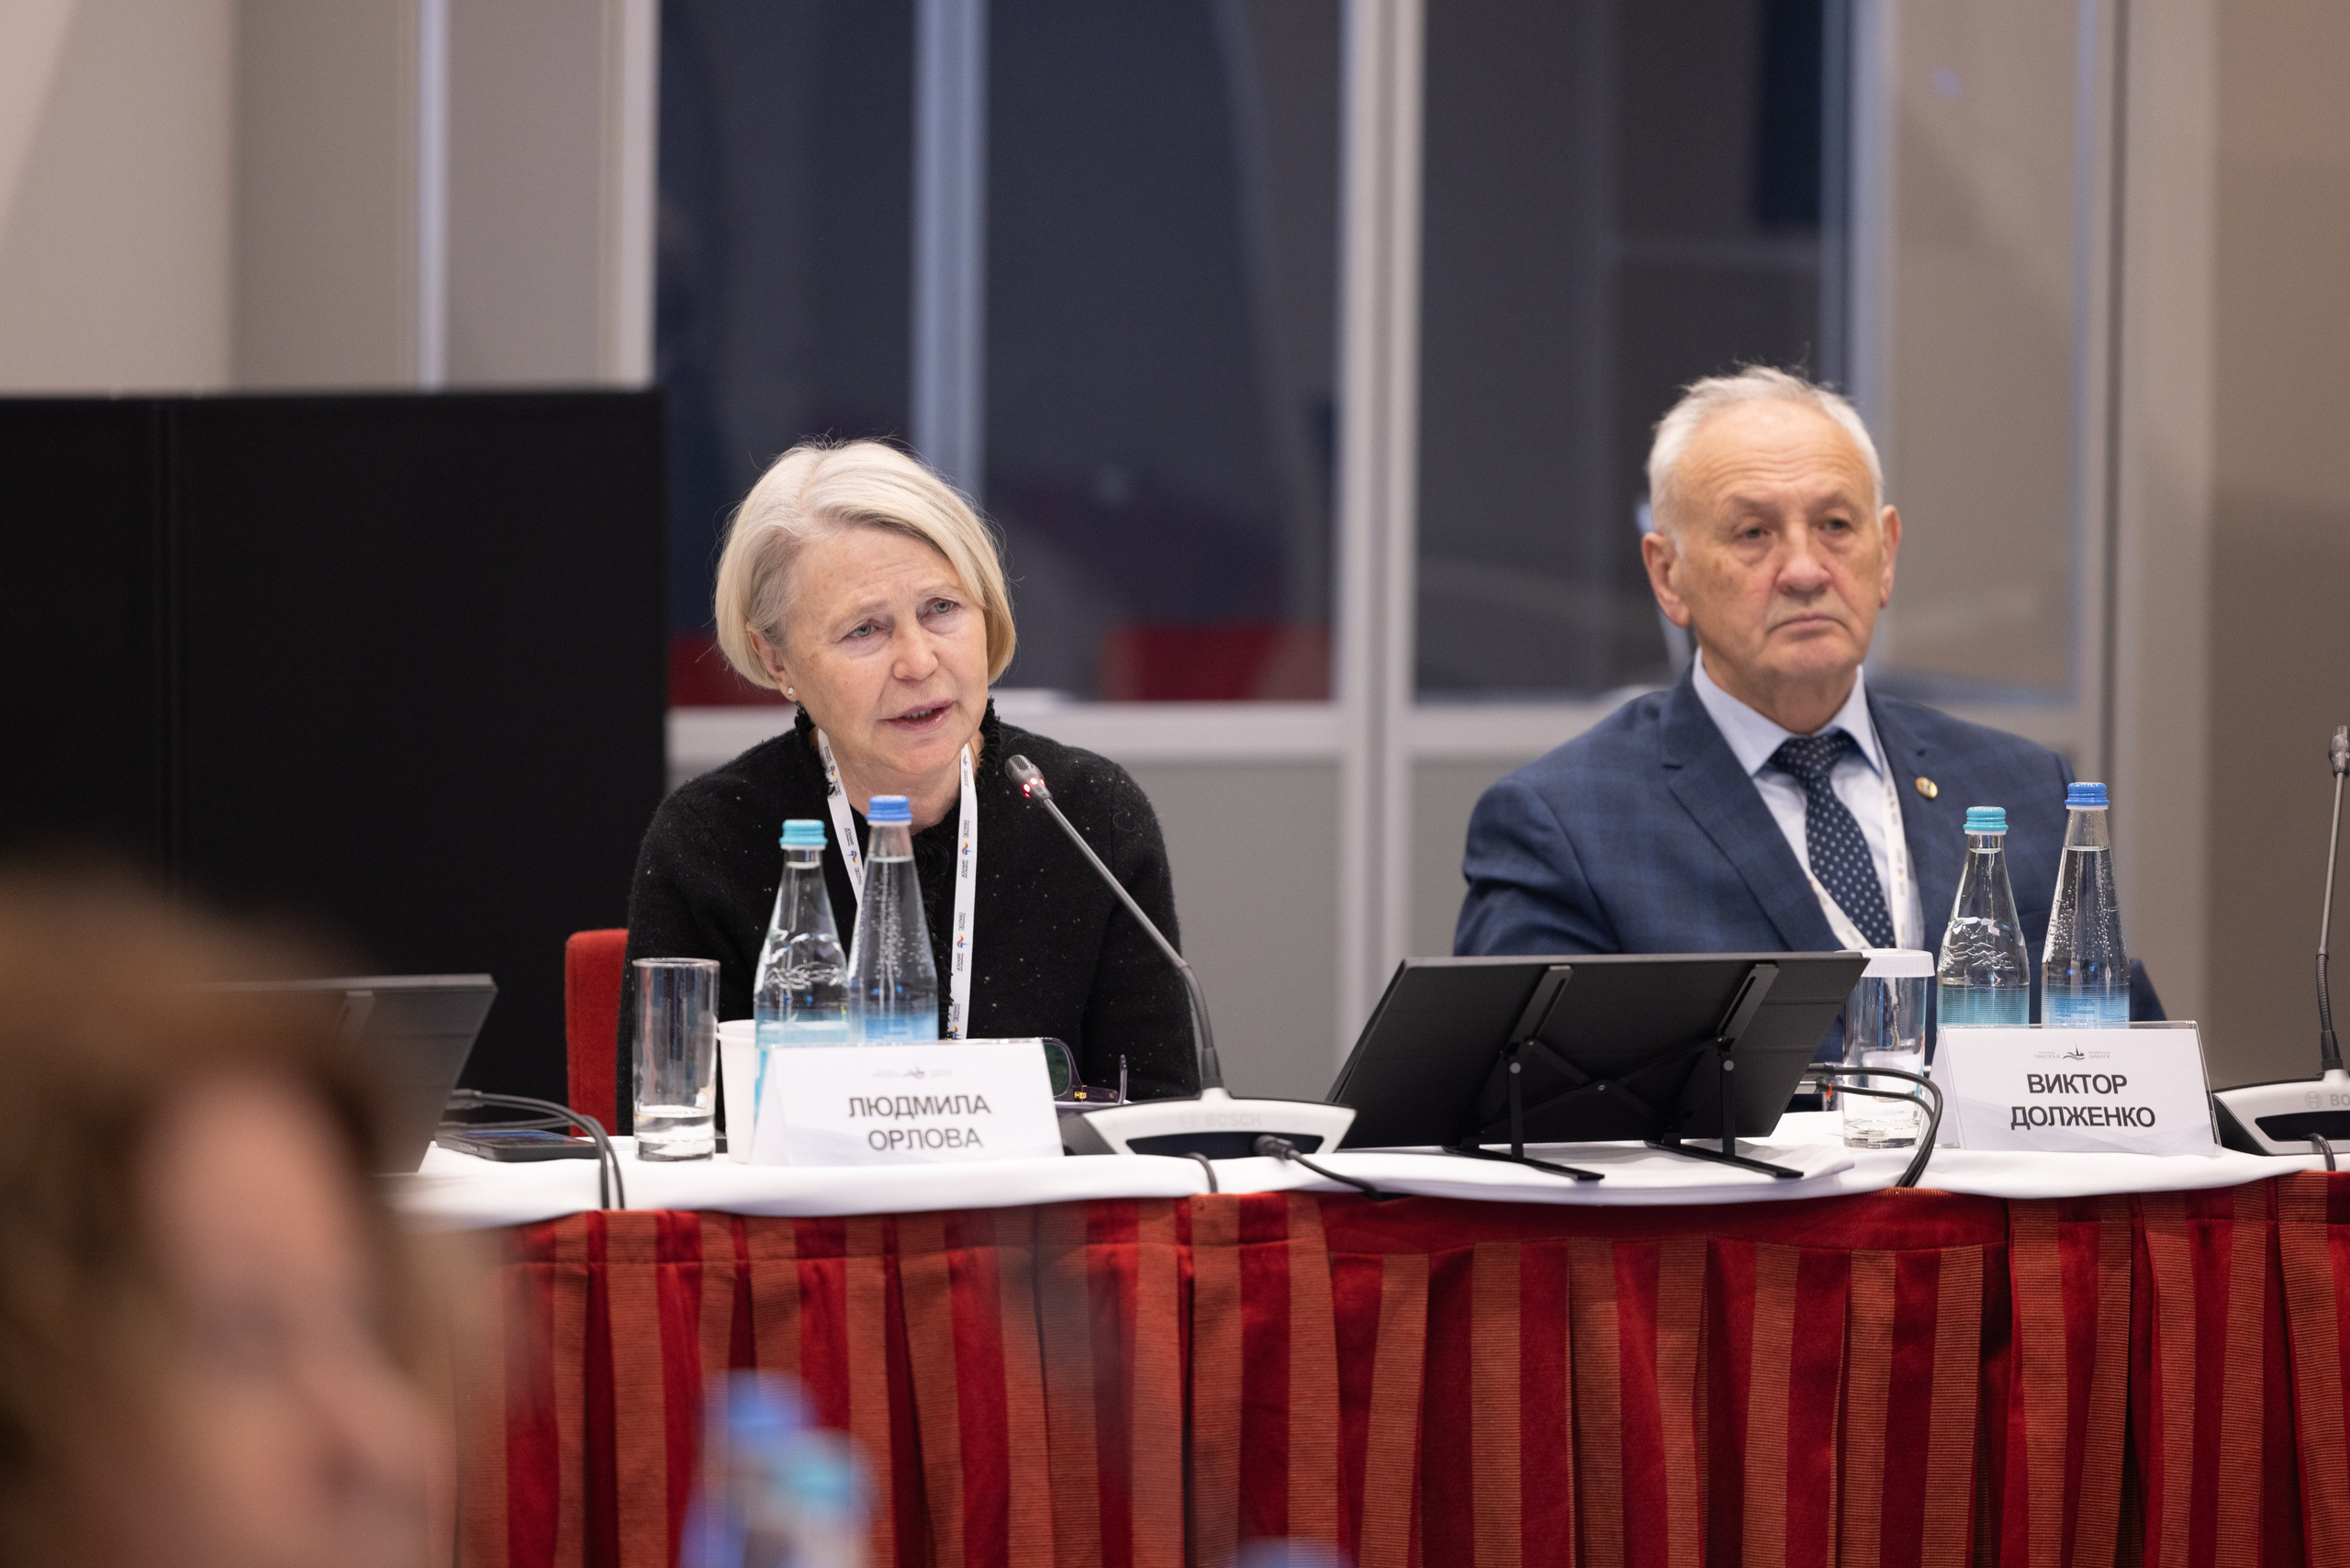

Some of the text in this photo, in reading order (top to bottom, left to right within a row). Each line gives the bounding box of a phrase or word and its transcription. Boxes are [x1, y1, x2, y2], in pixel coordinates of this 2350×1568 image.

[2027, 1073, 2127, 1094] ВИКТОР
[849, 1095, 991, 1120] ЛЮДМИЛА
[2010, 1106, 2155, 1130] ДОЛЖЕНКО
[1206, 1113, 1262, 1127] BOSCH
[867, 1128, 983, 1151] ОРЛОВА
